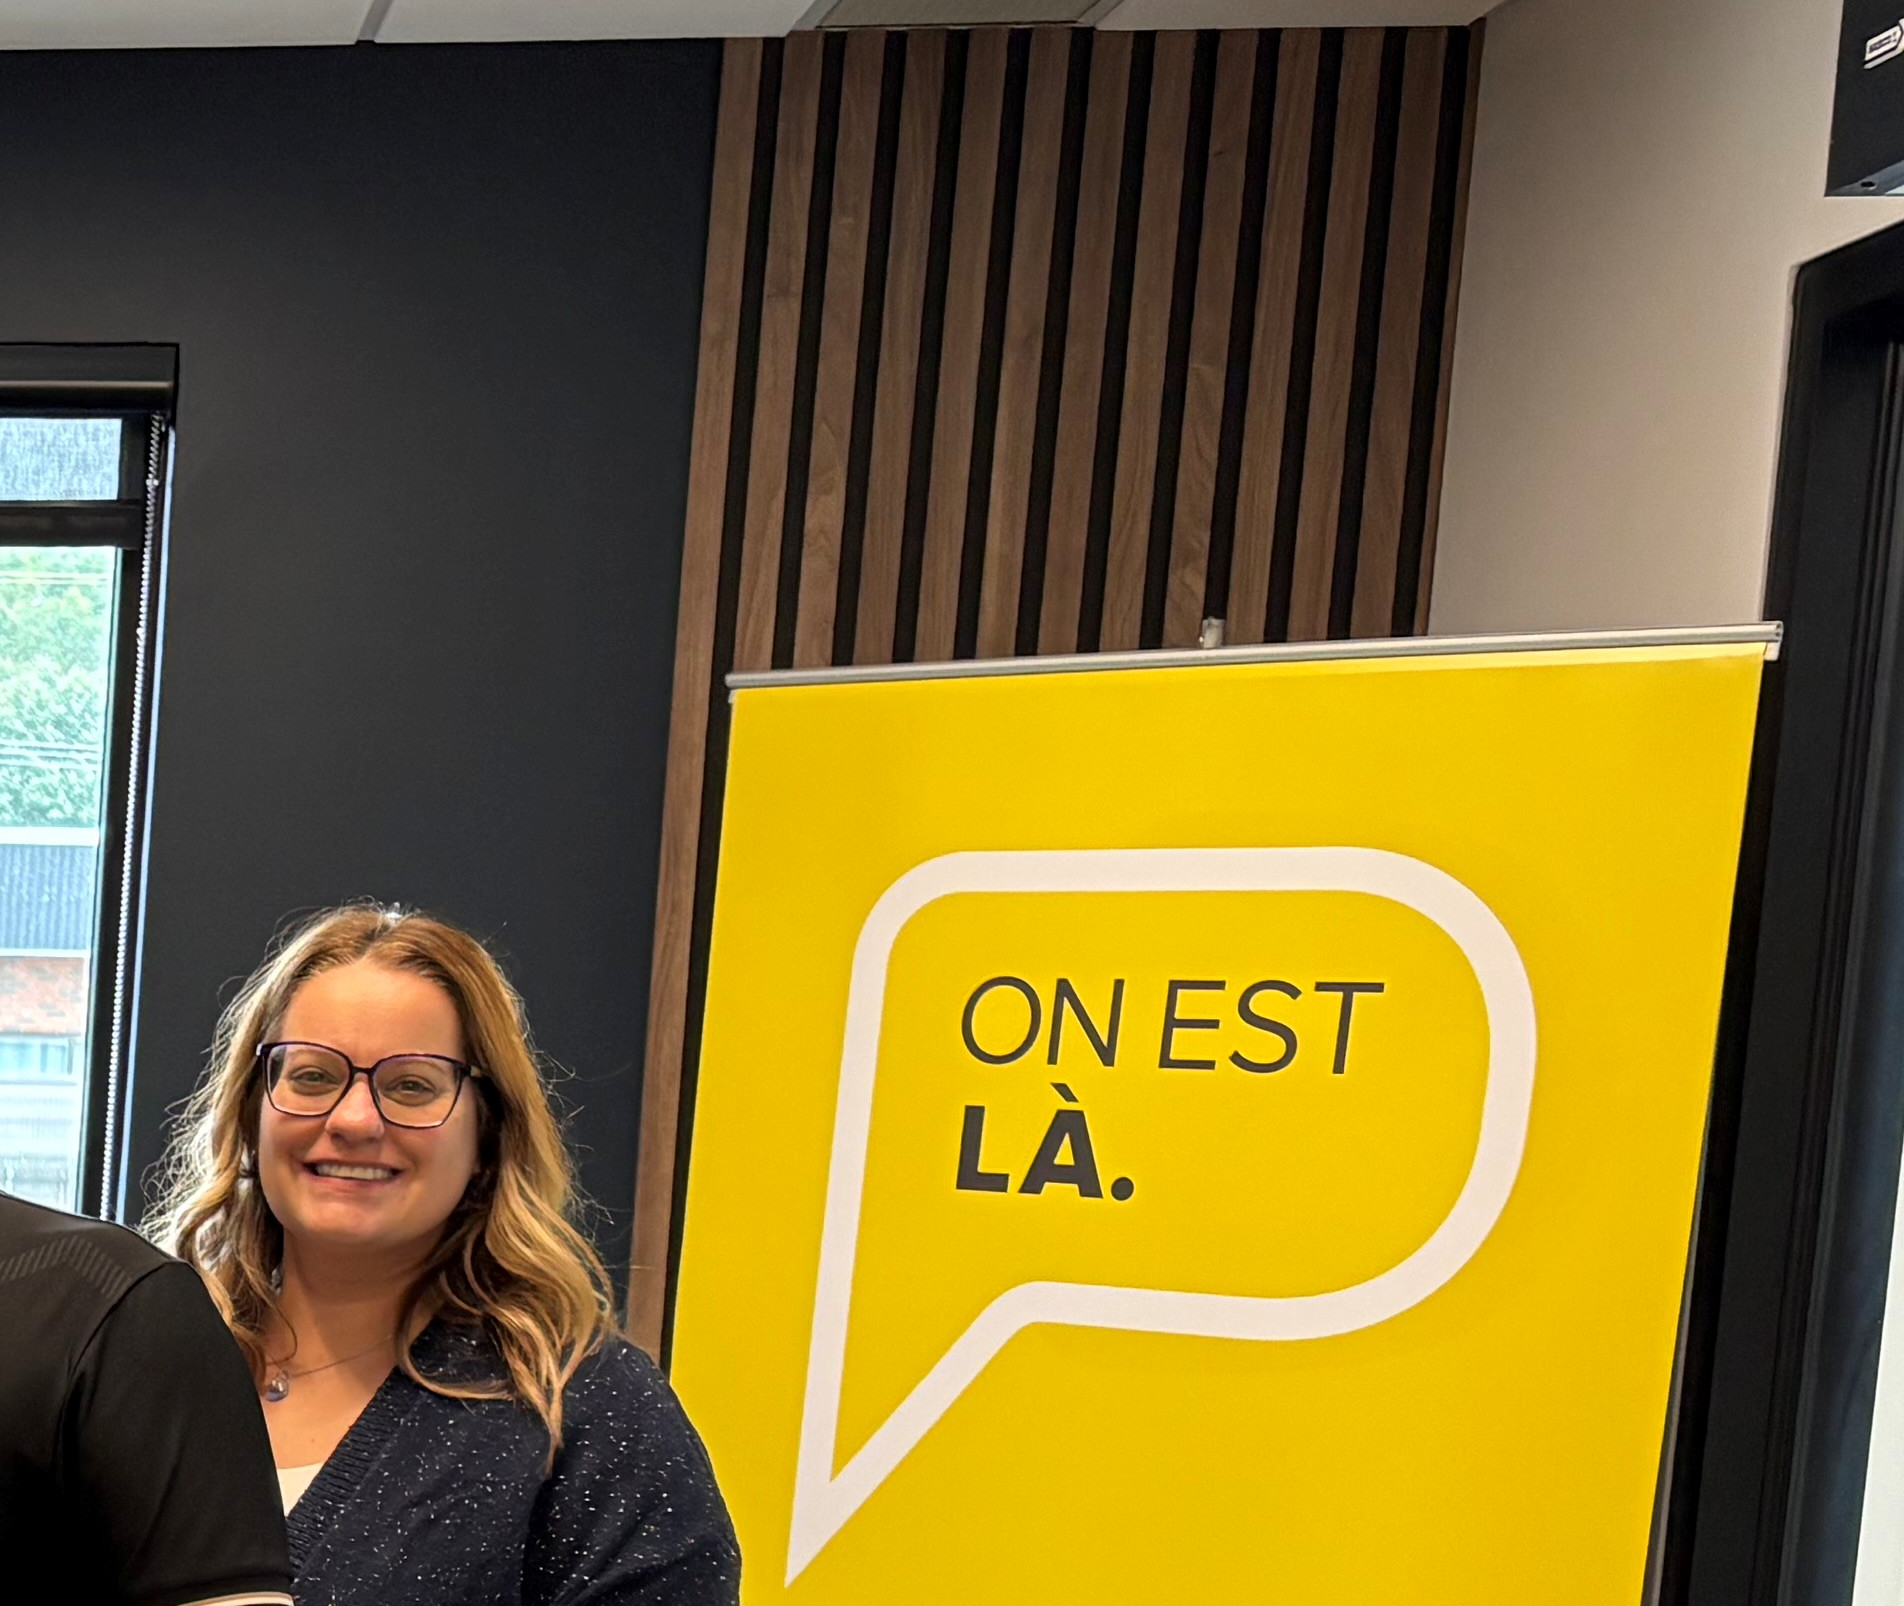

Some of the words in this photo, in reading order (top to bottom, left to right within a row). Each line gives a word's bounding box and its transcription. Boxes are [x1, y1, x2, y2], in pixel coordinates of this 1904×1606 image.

[961, 975, 1125, 1067] ON
[1158, 979, 1385, 1075] EST
[955, 1082, 1135, 1201] LÀ.
